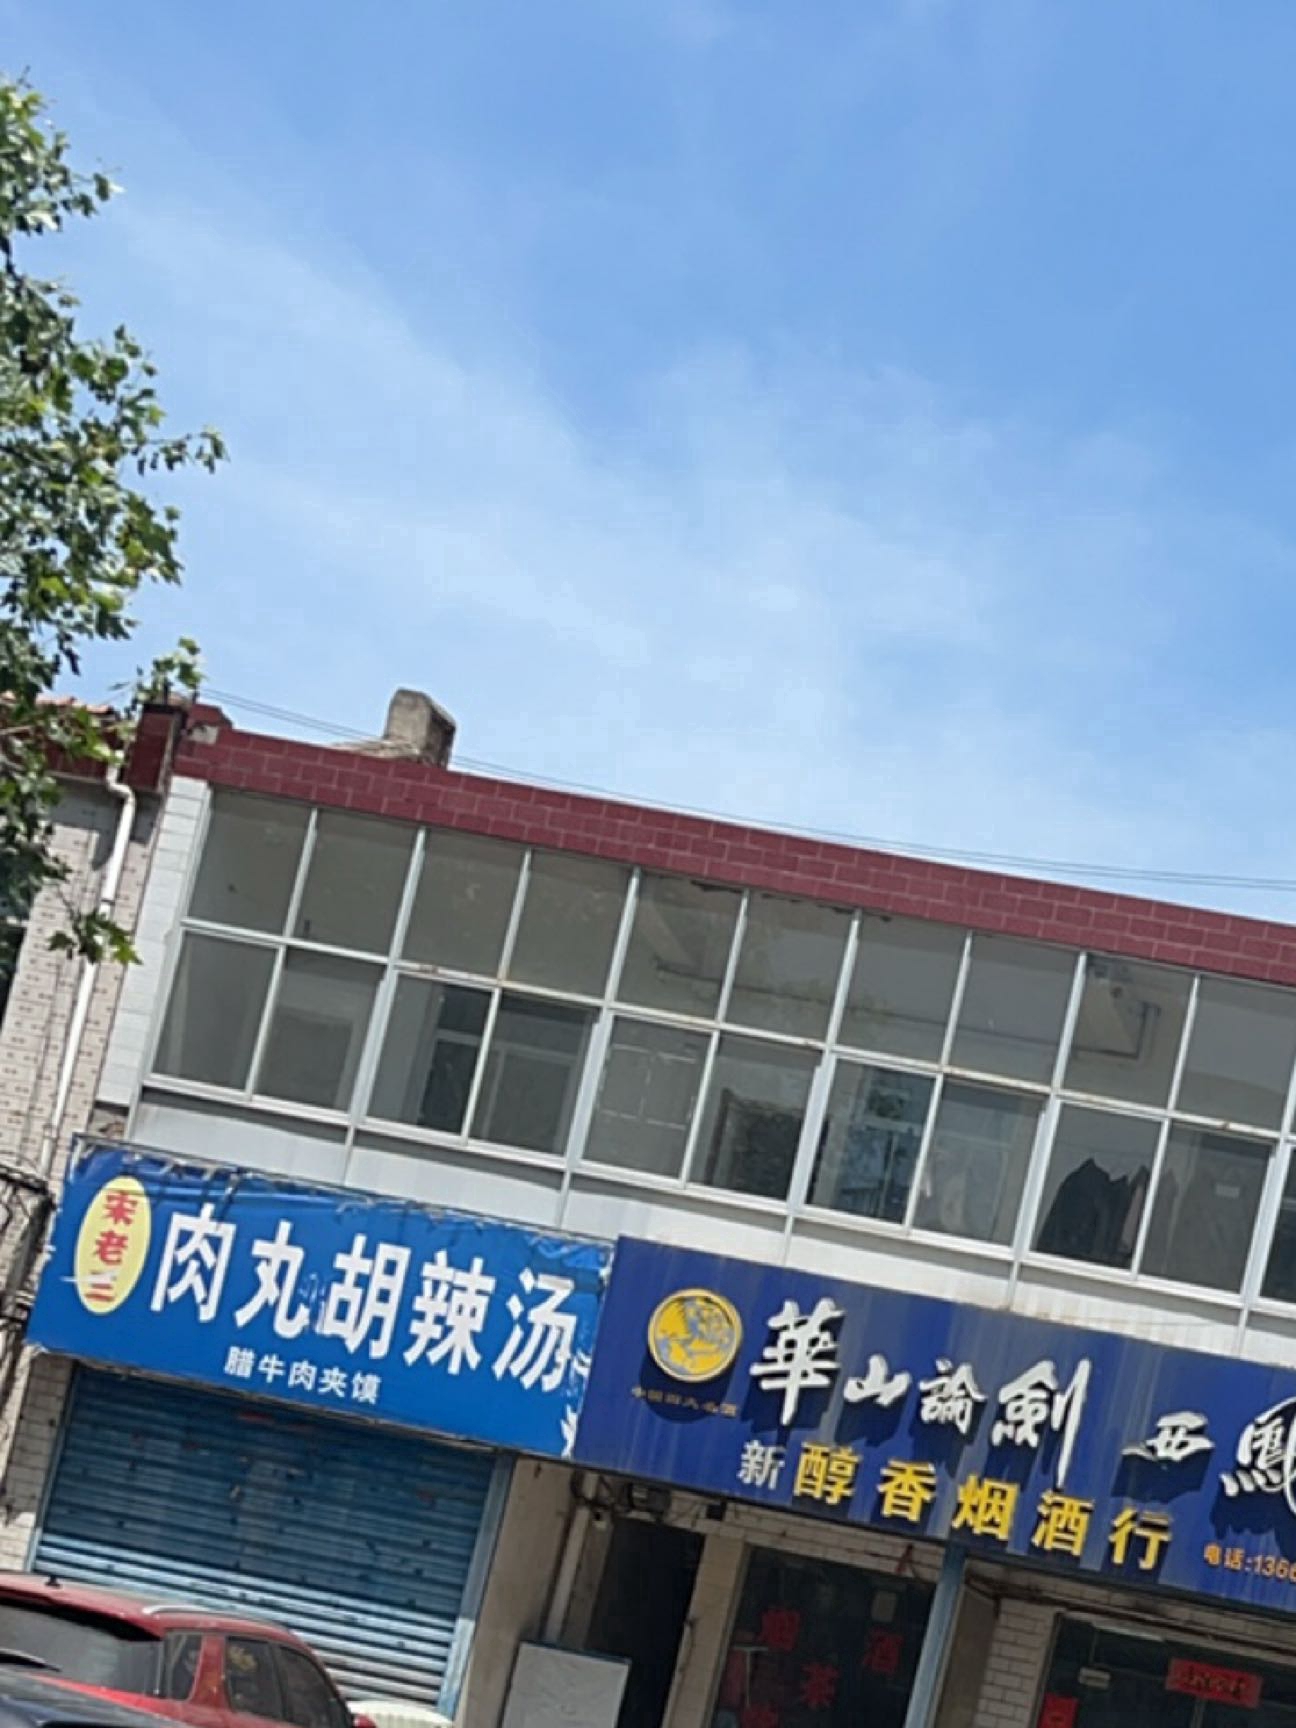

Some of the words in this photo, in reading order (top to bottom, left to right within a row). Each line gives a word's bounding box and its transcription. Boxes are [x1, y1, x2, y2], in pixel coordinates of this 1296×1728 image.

[149, 1203, 578, 1392] 肉丸胡辣汤
[736, 1440, 1172, 1570] 新醇香烟酒行
